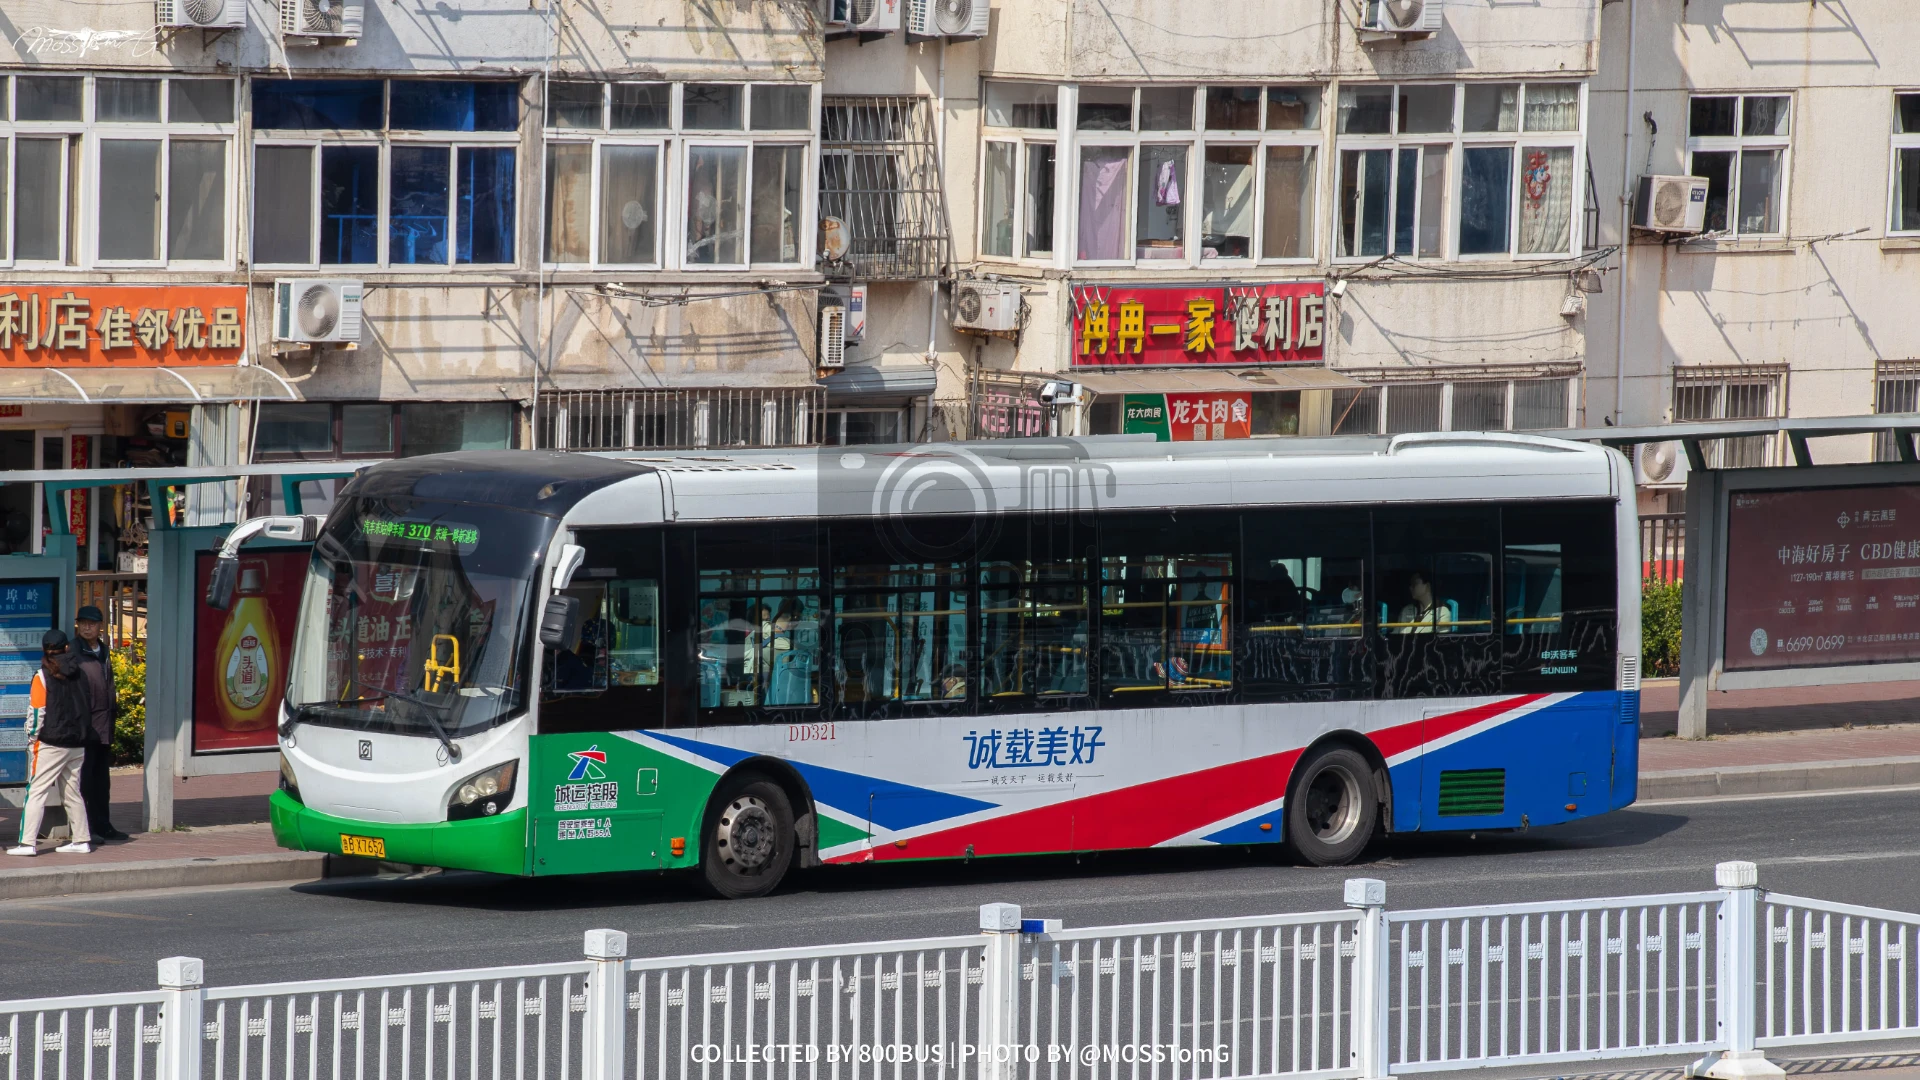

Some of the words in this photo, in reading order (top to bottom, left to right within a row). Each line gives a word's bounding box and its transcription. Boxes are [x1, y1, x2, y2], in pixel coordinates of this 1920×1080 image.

[0, 292, 90, 350] 利店
[95, 306, 241, 350] 佳邻优品
[1081, 297, 1215, 355] 冉冉一家
[1234, 293, 1324, 351] 便利店
[1127, 406, 1162, 419] 龙大肉食
[1172, 398, 1249, 424] 龙大肉食
[408, 524, 431, 538] 370
[1778, 543, 1851, 565] 中海好房子
[1787, 636, 1814, 652] 6699
[1816, 634, 1845, 651] 0699
[1541, 650, 1577, 660] 申沃客车
[242, 656, 253, 684] 头道
[1541, 666, 1577, 674] SUNWIN
[789, 722, 836, 741] DD321
[963, 726, 1106, 769] 诚载美好
[555, 782, 618, 803] 城运控股
